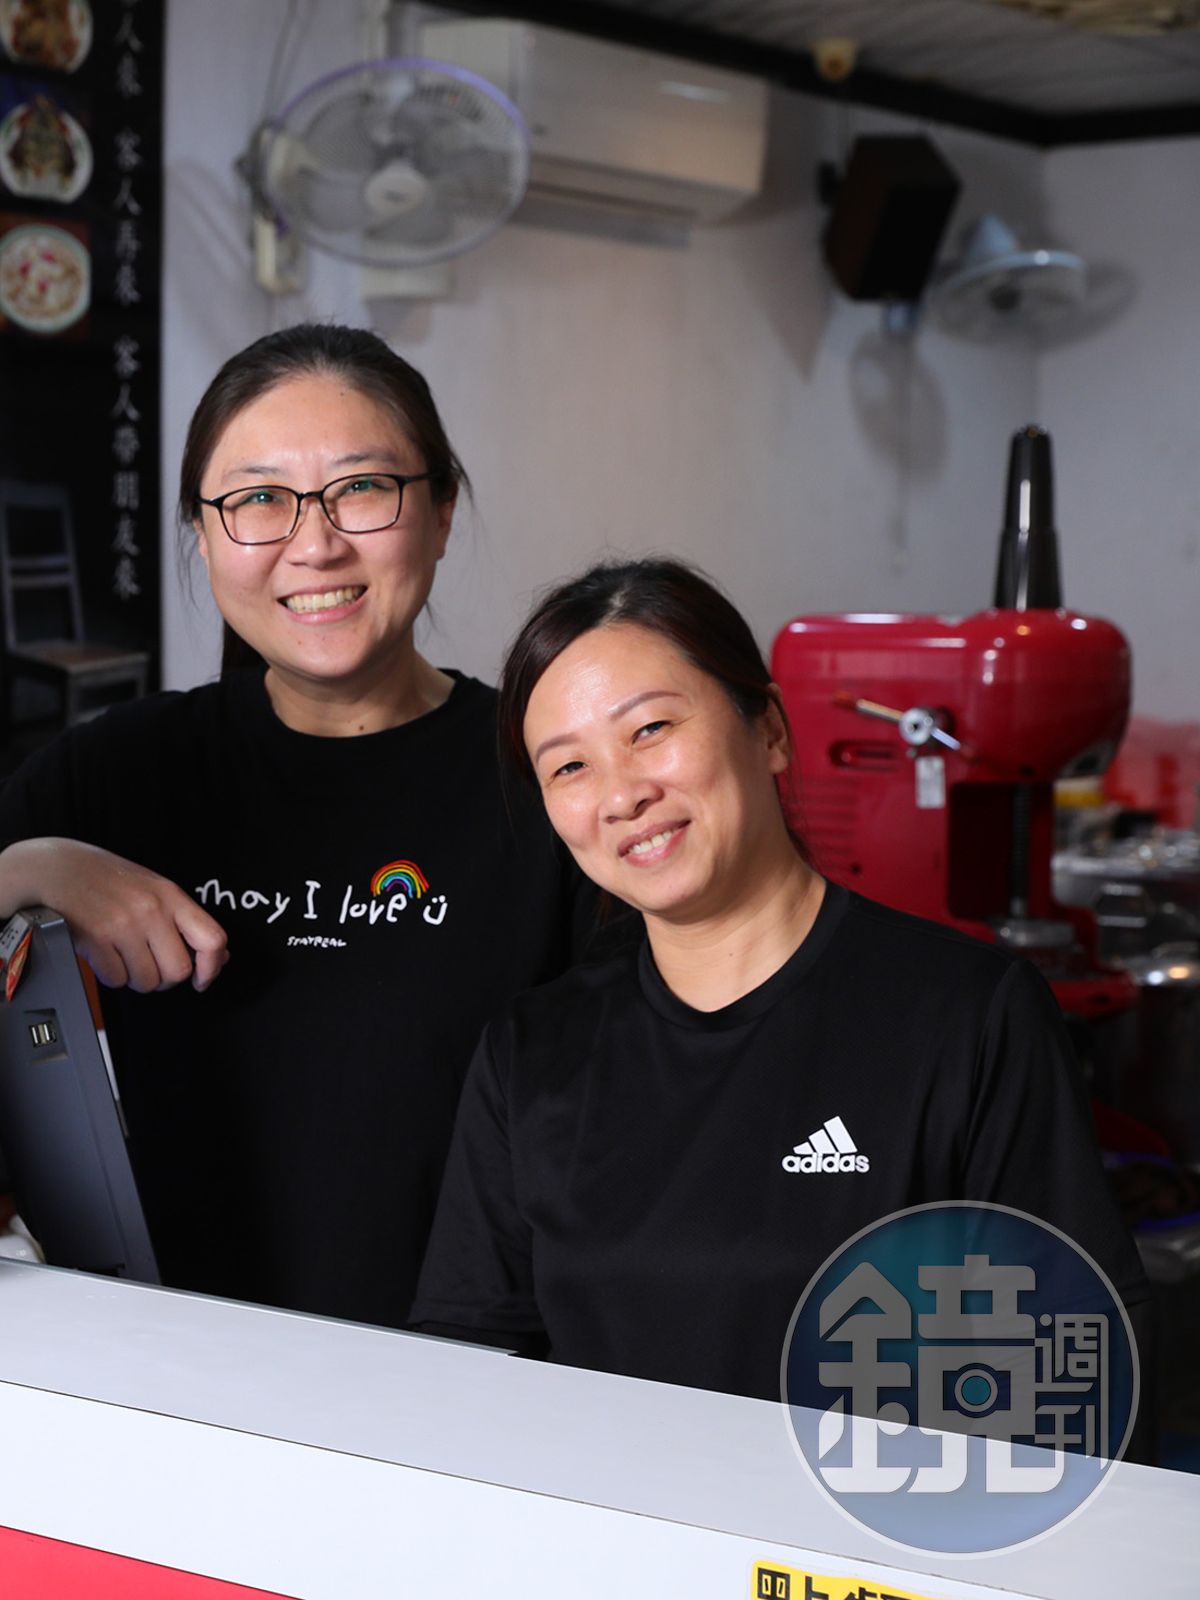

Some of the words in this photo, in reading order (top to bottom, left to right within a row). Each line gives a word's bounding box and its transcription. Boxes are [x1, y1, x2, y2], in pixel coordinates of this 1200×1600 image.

[195, 878, 291, 924] may
[303, 879, 322, 920] I
[338, 884, 408, 925] love
[781, 1151, 871, 1174] adidas
